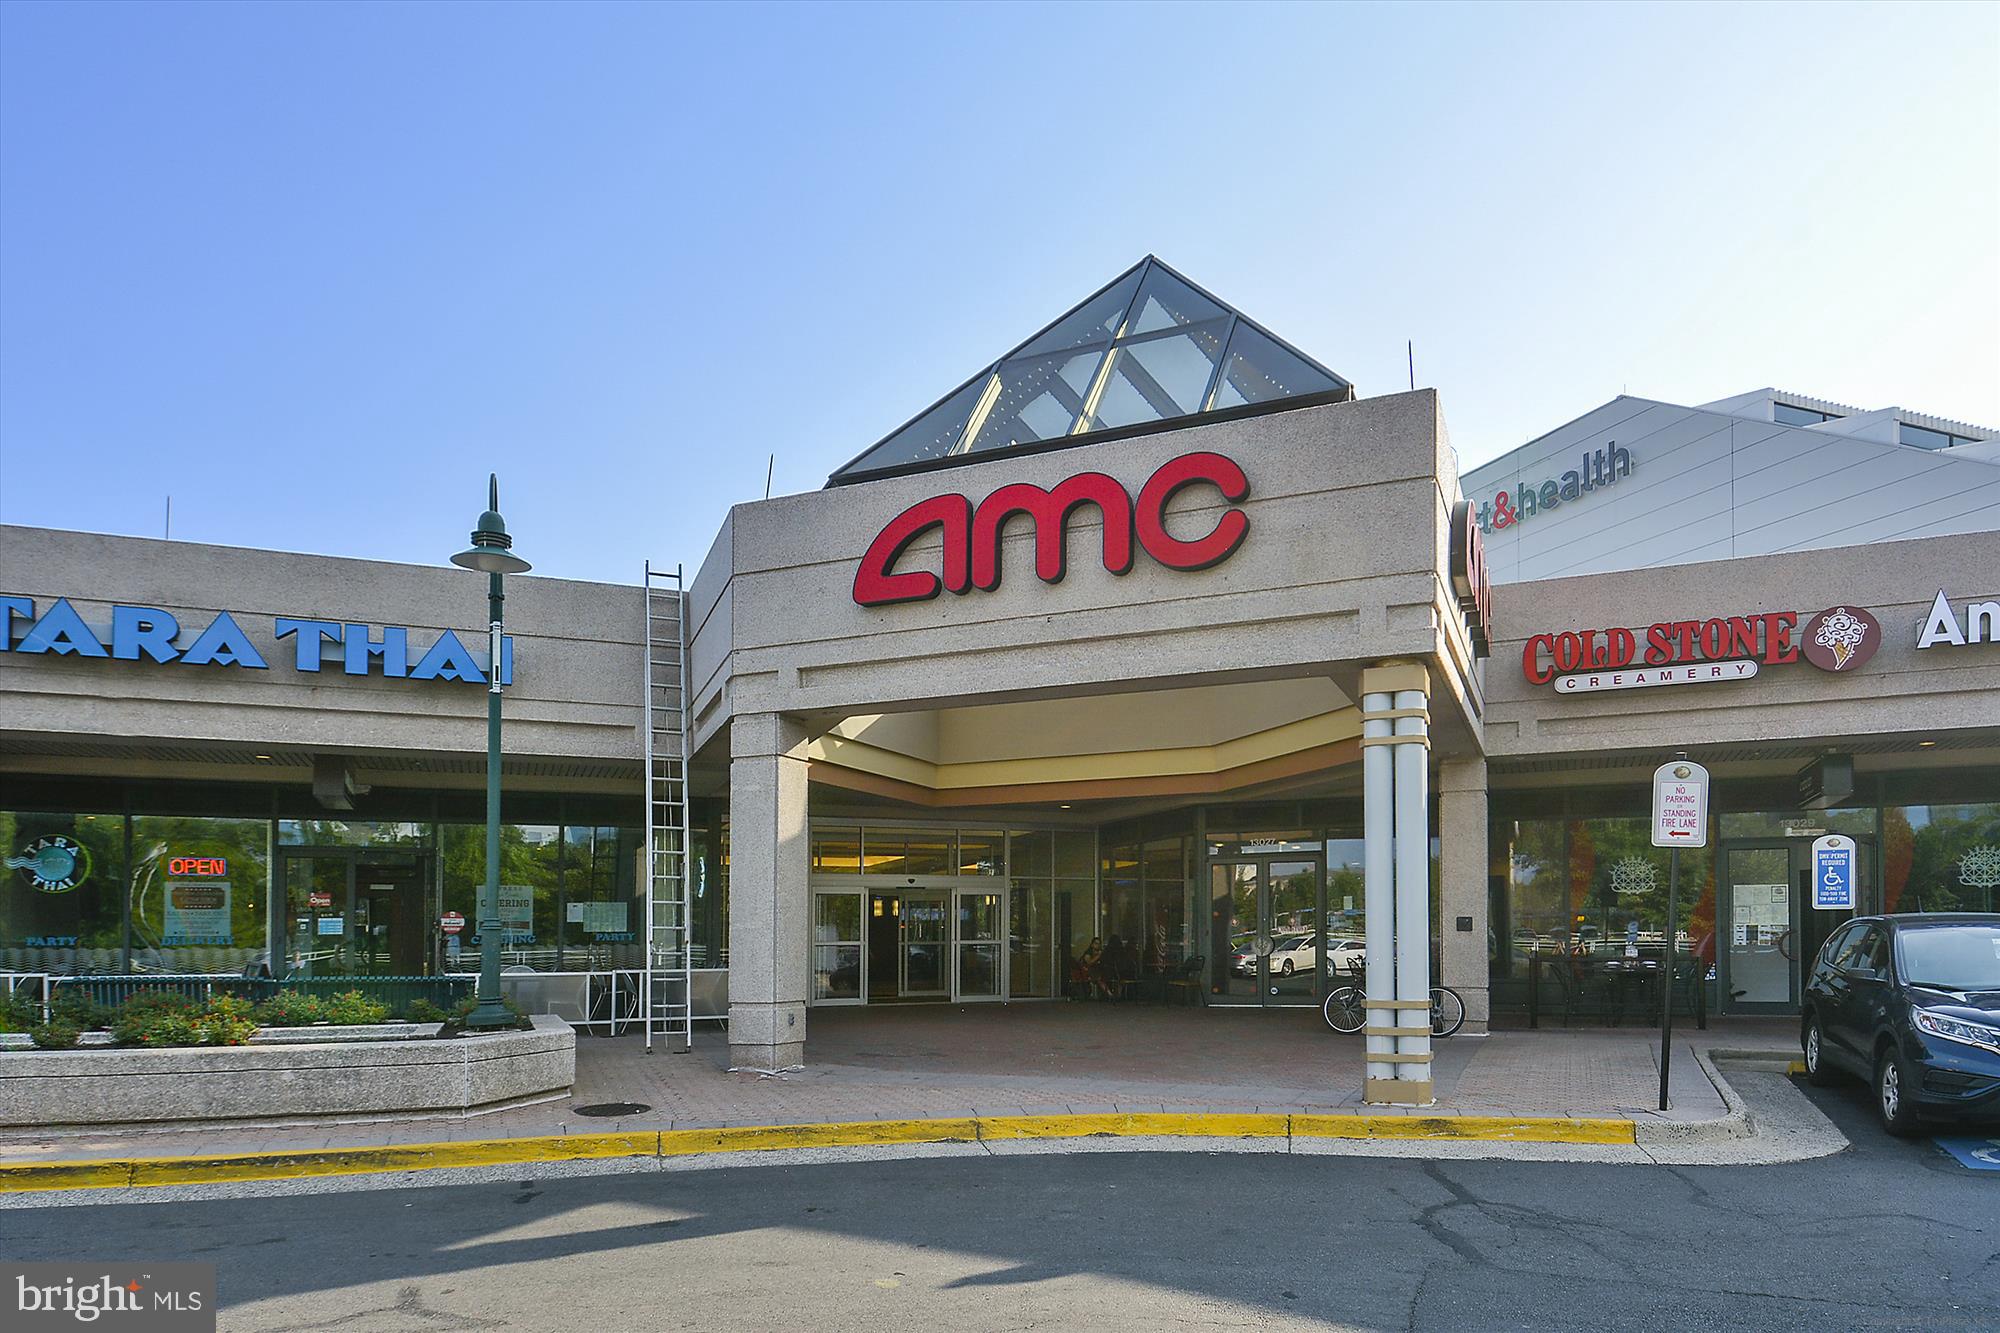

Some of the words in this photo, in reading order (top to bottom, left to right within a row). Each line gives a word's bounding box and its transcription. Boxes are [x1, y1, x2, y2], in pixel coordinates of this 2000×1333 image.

[1476, 441, 1631, 534] t&health
[1916, 588, 2000, 650] An
[1522, 627, 1636, 685] COLD
[1643, 610, 1799, 665] STONE
[1566, 664, 1747, 688] CREAMERY
[1675, 786, 1686, 795] NO
[1665, 795, 1696, 804] PARKING
[1663, 809, 1697, 818] STANDING
[1661, 818, 1676, 828] FIRE
[1679, 818, 1697, 829] LANE
[24, 837, 79, 857] TARA
[1250, 838, 1276, 846] 13027
[170, 858, 225, 875] OPEN
[32, 875, 75, 891] THAI
[480, 899, 530, 908] CERING
[25, 936, 78, 946] PARTY
[471, 935, 537, 944] CING
[595, 932, 636, 942] PARTY
